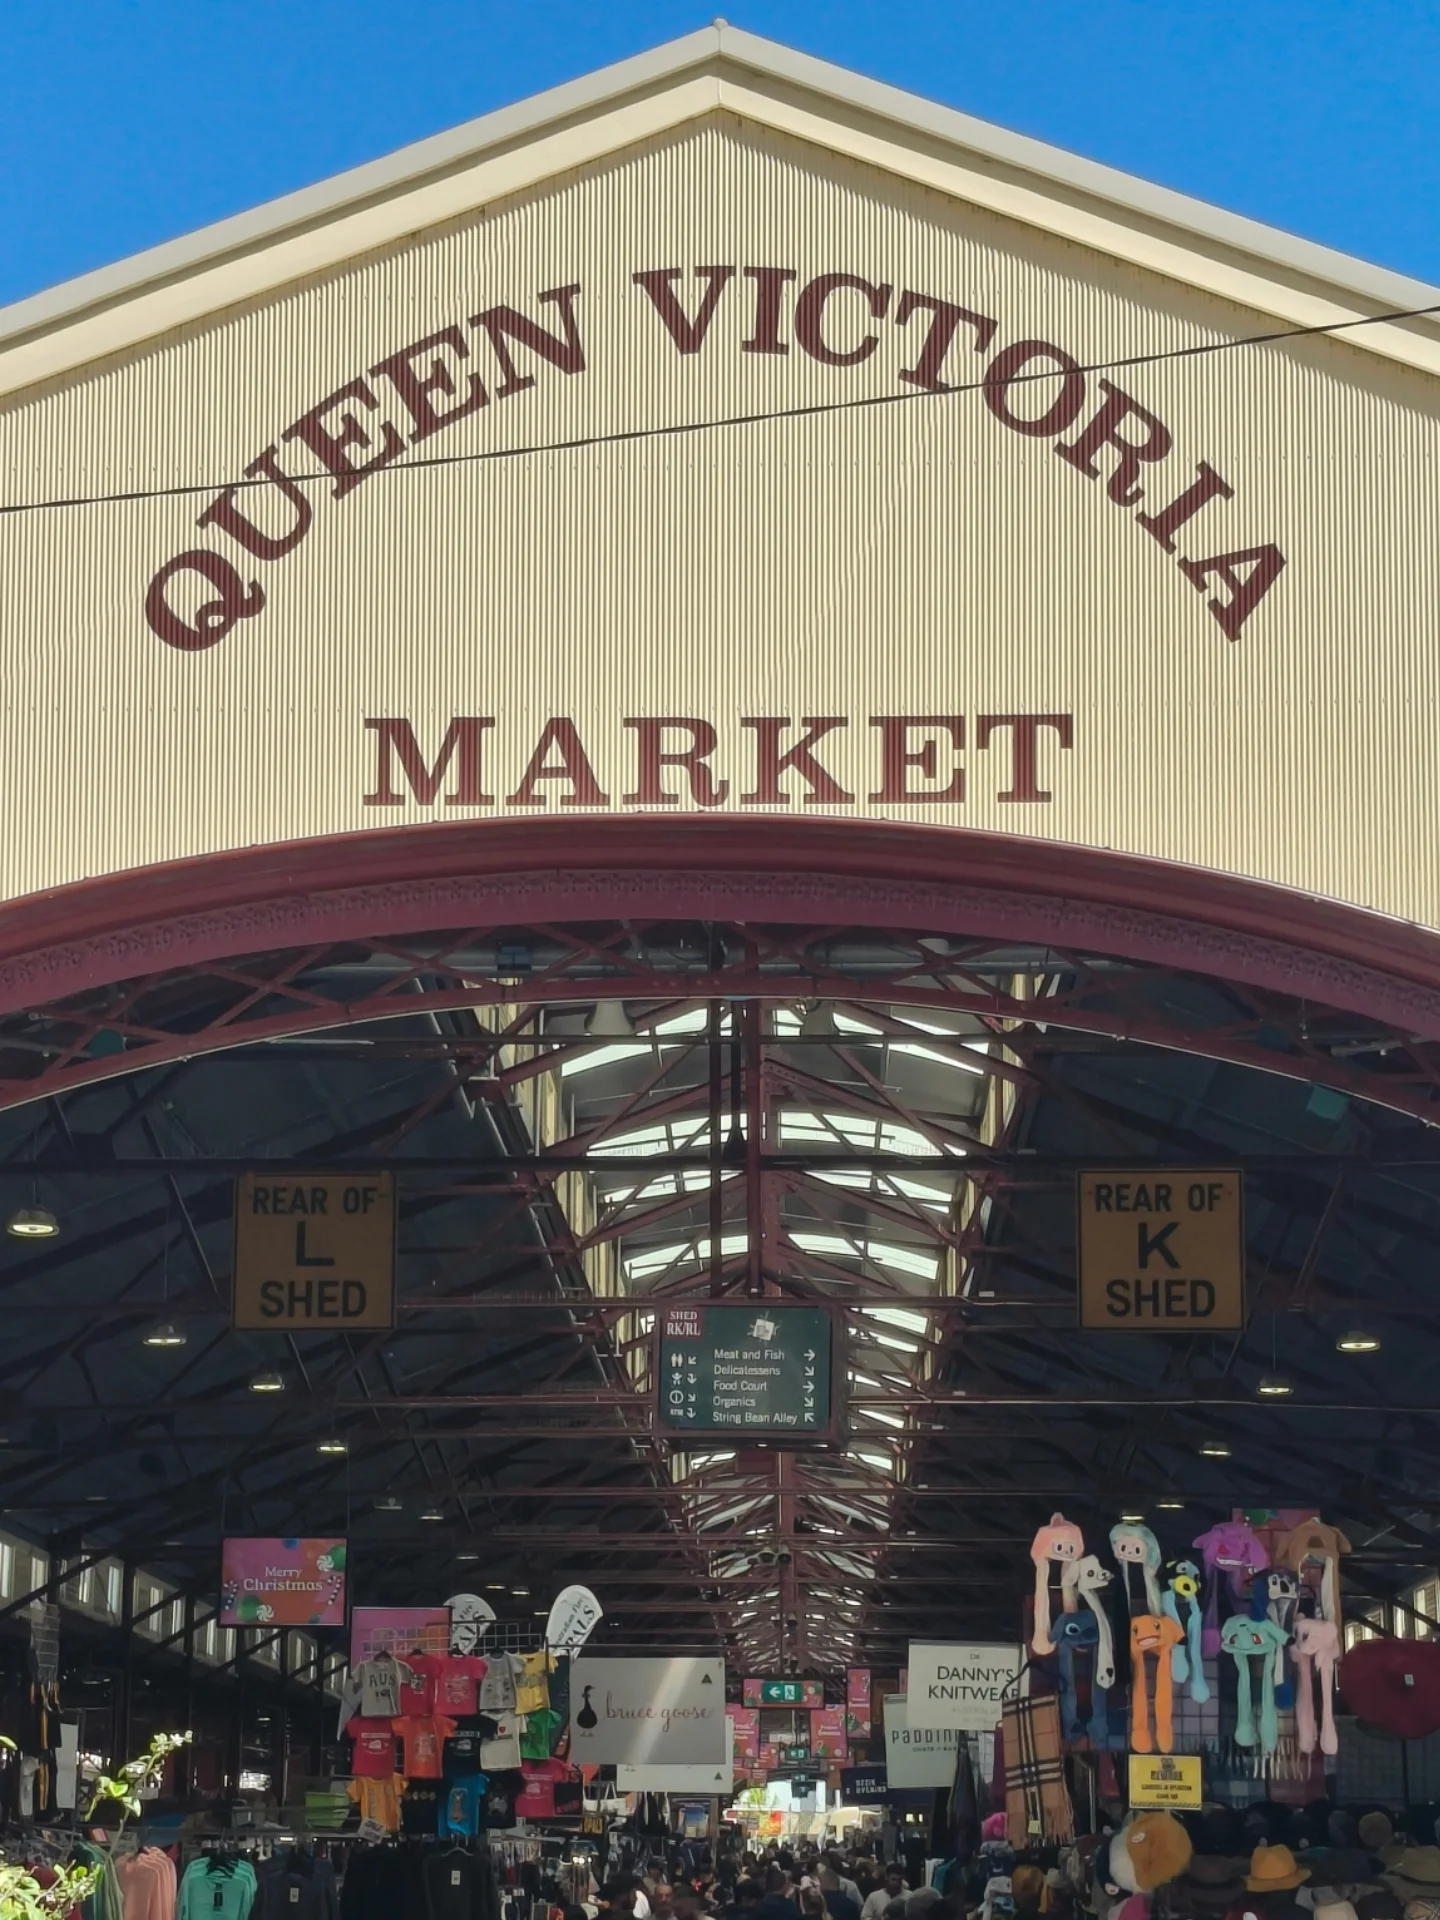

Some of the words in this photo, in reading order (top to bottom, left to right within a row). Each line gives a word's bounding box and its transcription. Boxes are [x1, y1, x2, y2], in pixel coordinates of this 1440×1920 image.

[145, 283, 587, 652] QUEEN
[632, 265, 1287, 642] VICTORIA
[363, 713, 1073, 807] MARKET
[252, 1187, 328, 1215] REAR
[342, 1187, 377, 1214] OF
[1095, 1183, 1172, 1212] REAR
[1188, 1183, 1223, 1212] OF
[295, 1220, 336, 1267] L
[1138, 1222, 1181, 1269] K
[259, 1280, 367, 1318] SHED
[1106, 1279, 1216, 1317] SHED
[670, 1311, 697, 1320] SHED
[666, 1322, 700, 1336] RK/RL
[714, 1349, 739, 1360] Meat
[742, 1349, 760, 1360] and
[764, 1349, 785, 1360] Fish
[714, 1364, 781, 1376] Delicatessens
[713, 1380, 737, 1391] Food
[740, 1380, 767, 1391] Court
[713, 1395, 756, 1408] Organics
[712, 1411, 742, 1424] String
[745, 1412, 770, 1423] Bean
[773, 1412, 798, 1425] Alley
[265, 1567, 302, 1578] Merry
[243, 1578, 323, 1591] Christmas
[937, 1666, 1014, 1683] DANNY'S
[604, 1690, 658, 1720] bruce
[661, 1706, 713, 1733] goose
